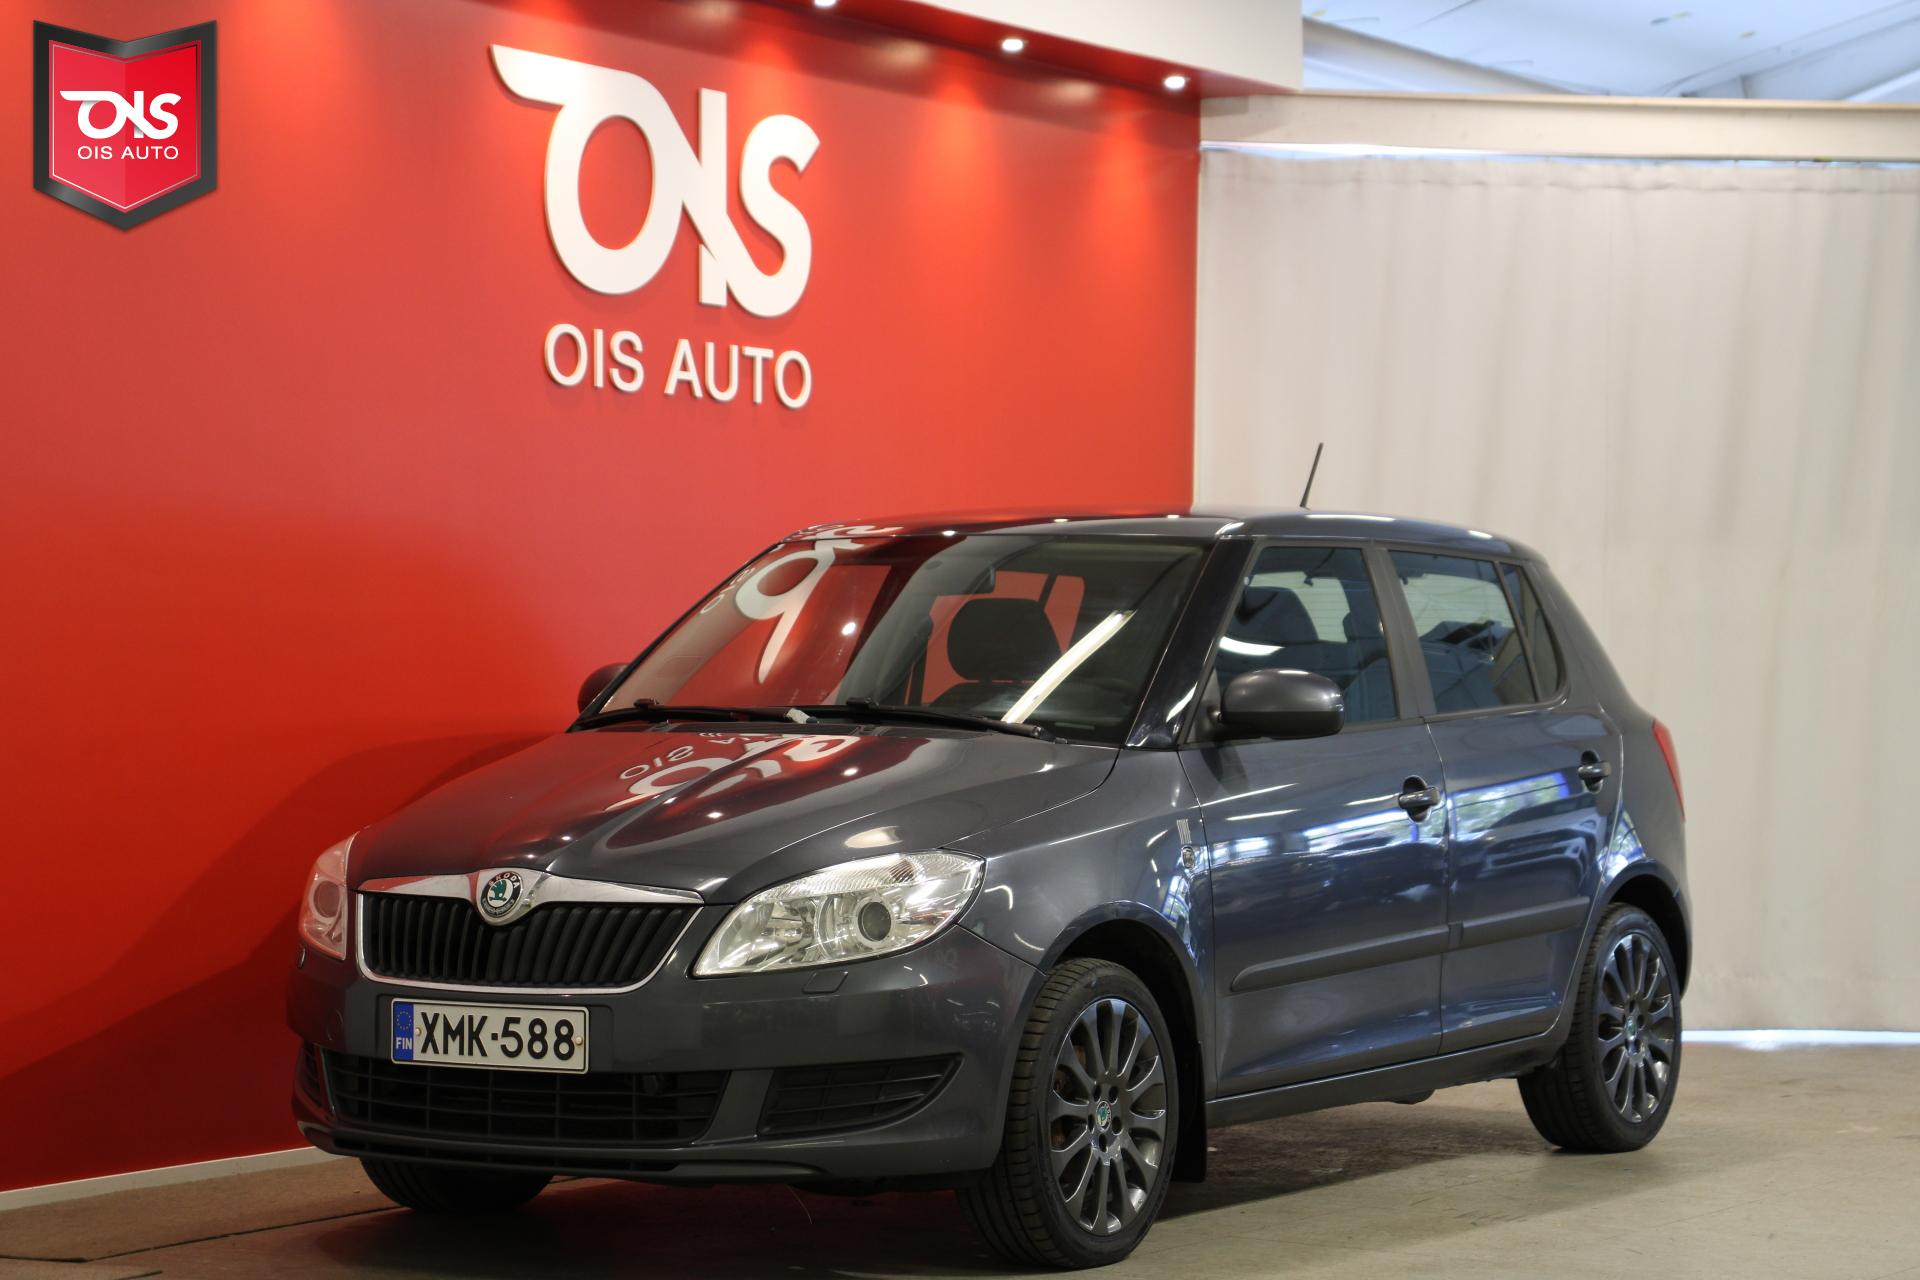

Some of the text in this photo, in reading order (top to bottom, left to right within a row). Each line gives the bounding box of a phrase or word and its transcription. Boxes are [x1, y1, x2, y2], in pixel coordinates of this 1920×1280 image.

[544, 323, 812, 409] OIS AUTO
[396, 1036, 413, 1051] FIN
[420, 1012, 575, 1061] XMK-588
